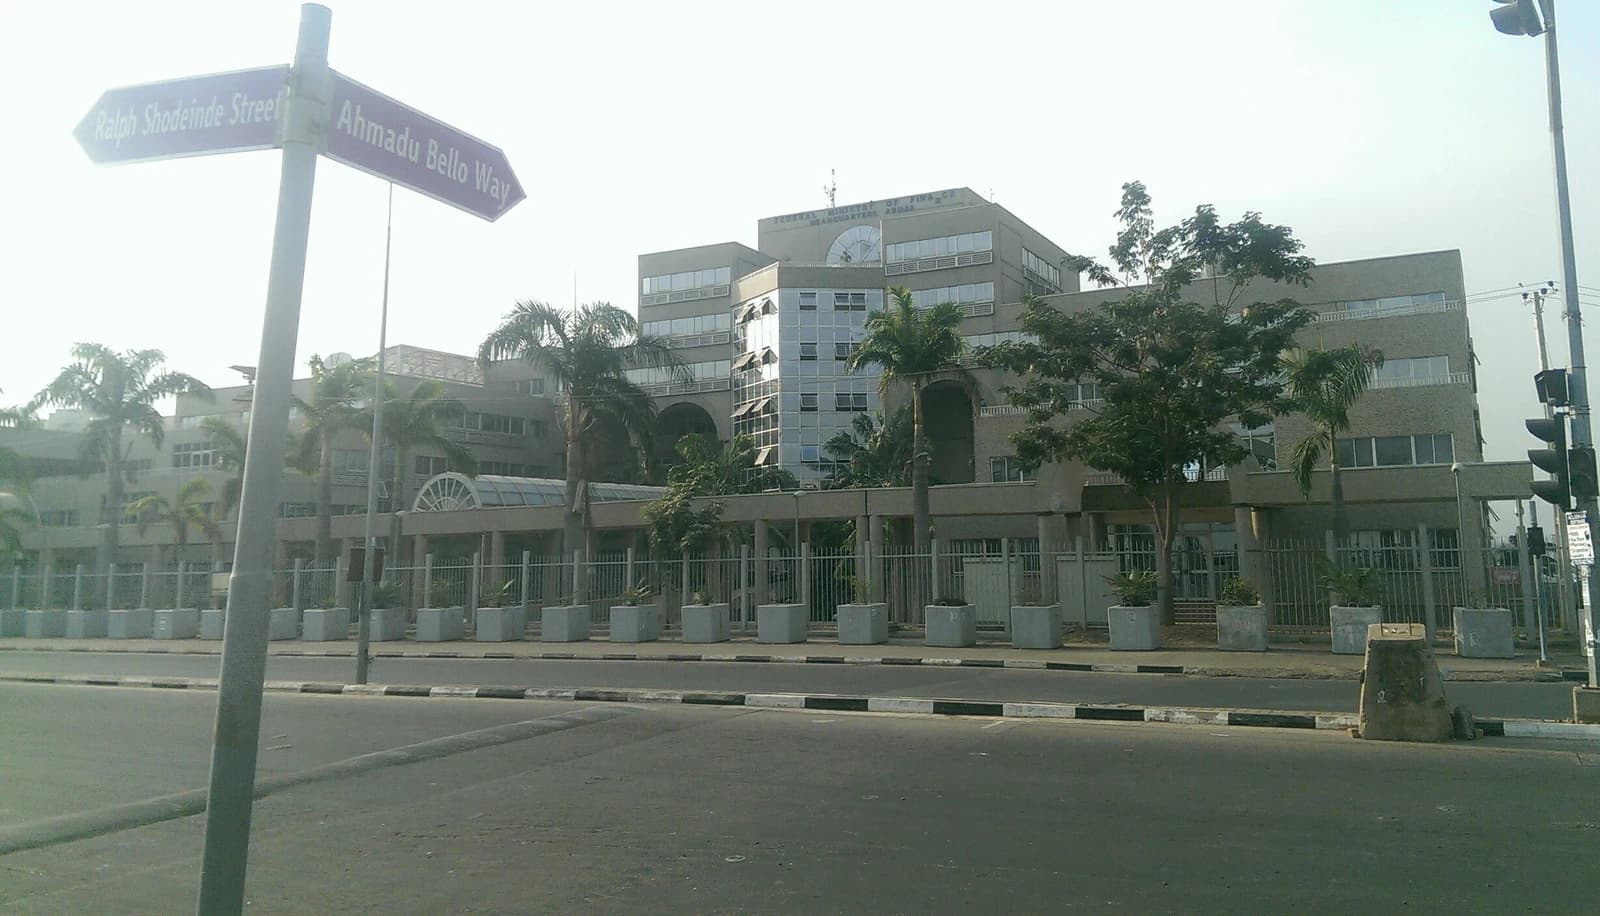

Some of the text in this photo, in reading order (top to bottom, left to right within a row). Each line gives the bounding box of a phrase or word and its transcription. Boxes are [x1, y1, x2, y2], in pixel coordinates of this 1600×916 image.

[94, 110, 137, 148] Ralph
[142, 98, 223, 136] Shodeinde
[336, 100, 510, 210] Ahmadu Bello Way
[774, 212, 817, 224] FEDERAL
[827, 204, 874, 216] MINISTRY
